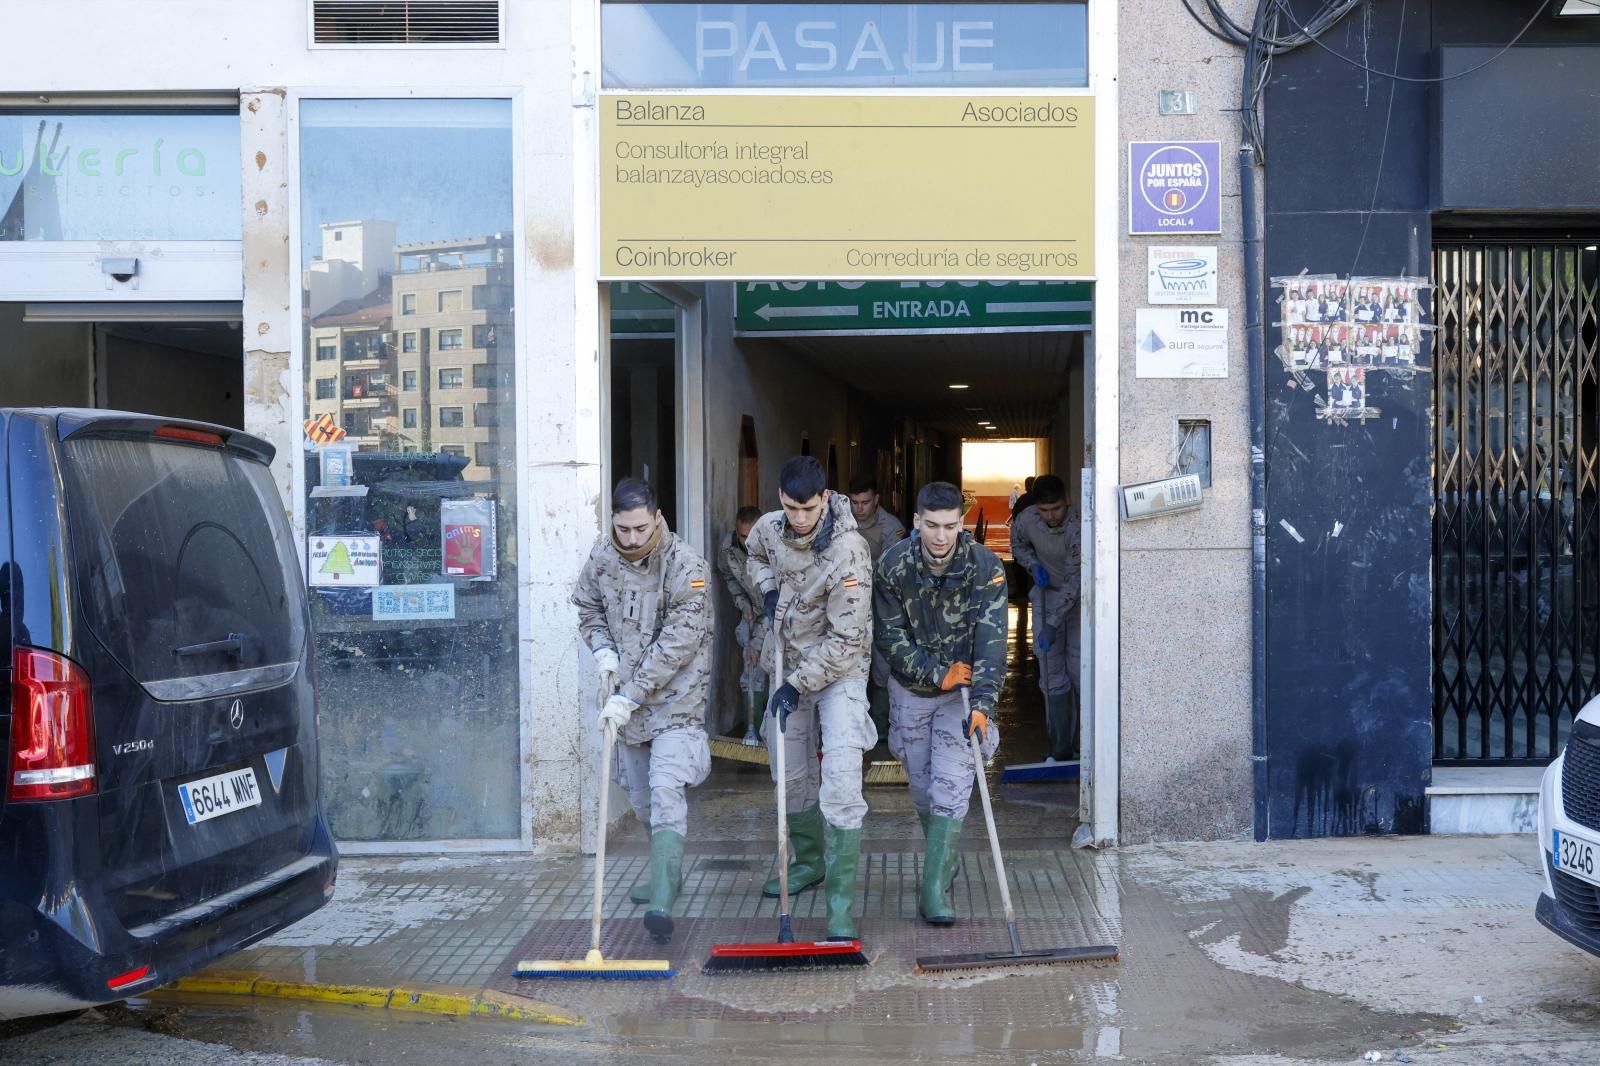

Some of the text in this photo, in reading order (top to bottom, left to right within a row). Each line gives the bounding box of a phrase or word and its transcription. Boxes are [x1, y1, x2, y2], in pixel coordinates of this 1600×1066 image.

[695, 20, 995, 74] PASAJE
[616, 100, 1078, 122] Balanza Asociados
[615, 140, 809, 164] Consultoría integral
[615, 165, 833, 187] balanzayasociados.es
[1147, 163, 1202, 177] JUNTOS
[1147, 177, 1202, 187] POR ESPAÑA
[1158, 218, 1194, 227] LOCAL 4
[615, 246, 1078, 271] Coinbroker Correduría de seguros
[872, 300, 971, 319] ENTRADA
[1180, 310, 1214, 324] mc
[1168, 341, 1195, 350] aura
[192, 773, 255, 816] 6644 MNF
[1562, 838, 1594, 875] 3246
